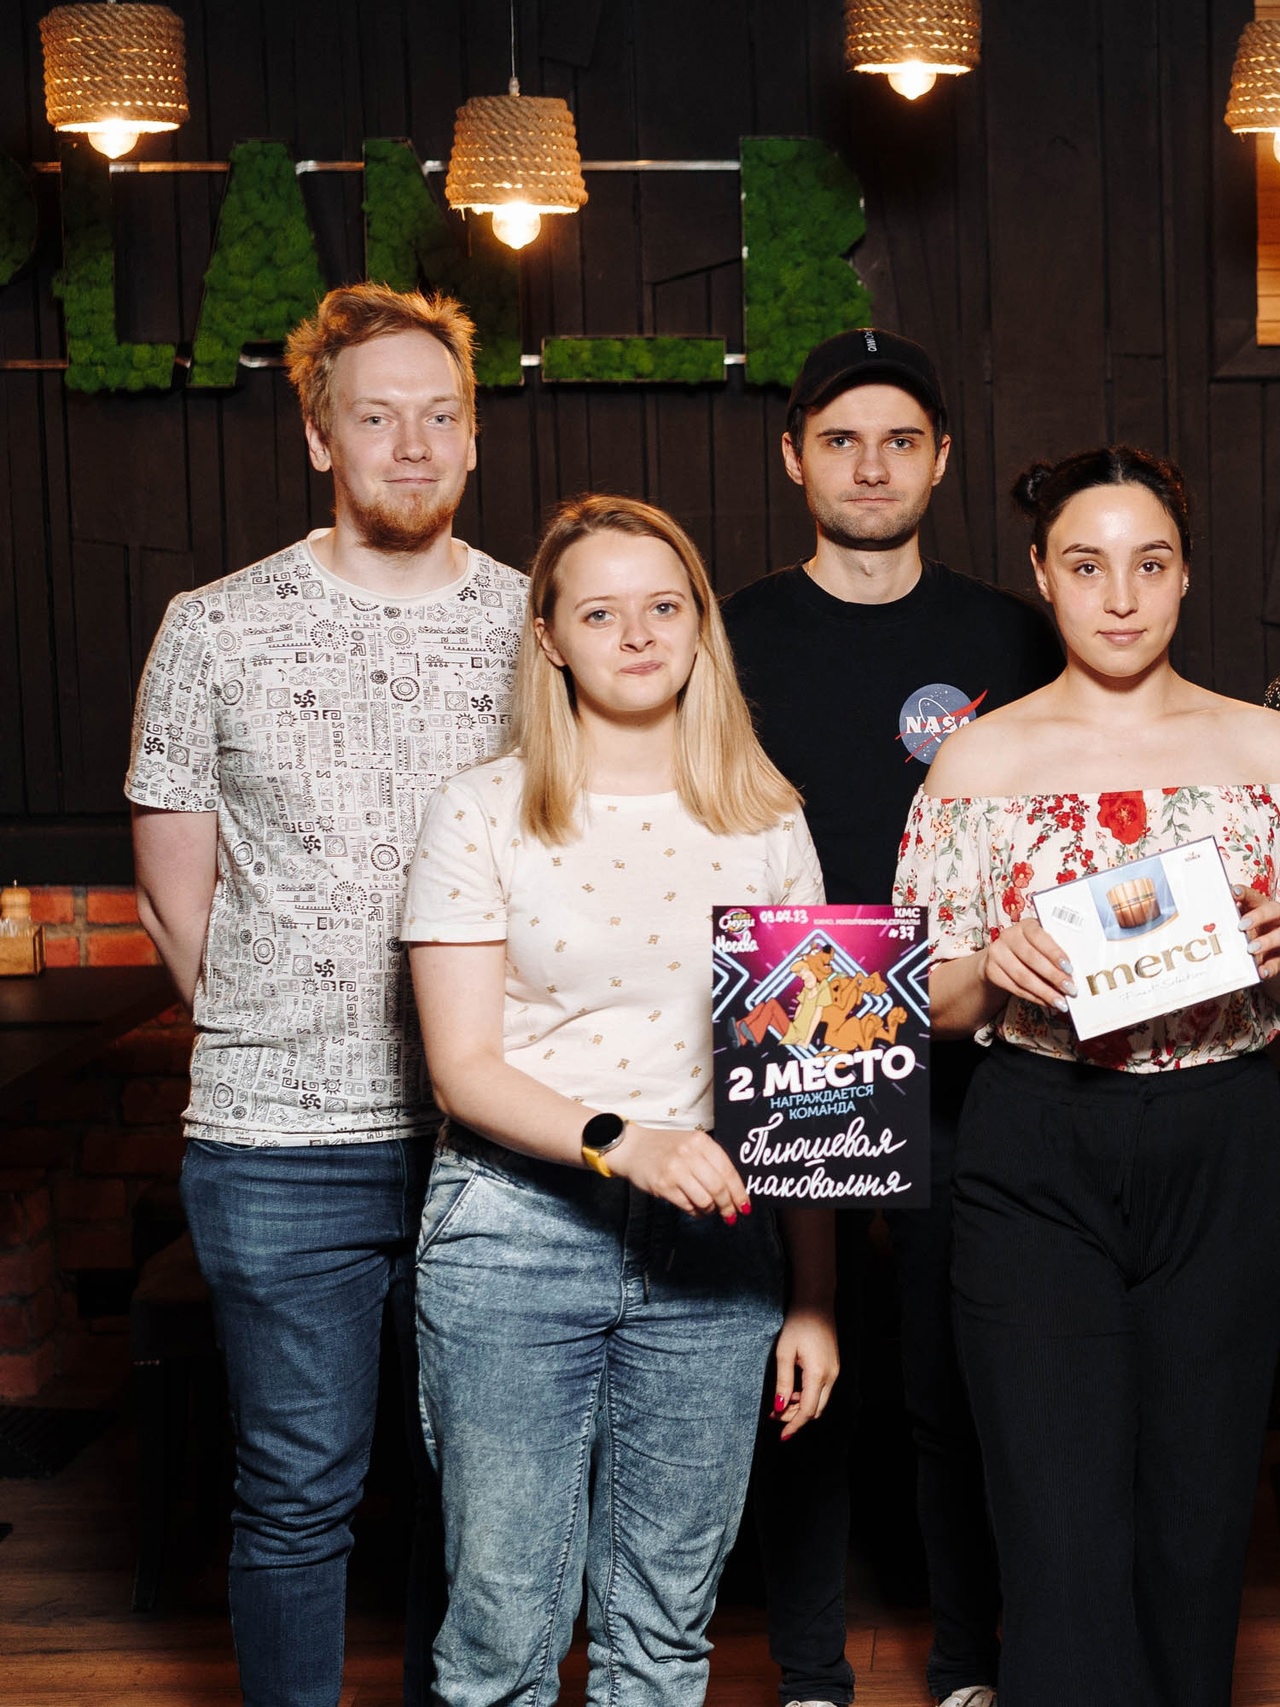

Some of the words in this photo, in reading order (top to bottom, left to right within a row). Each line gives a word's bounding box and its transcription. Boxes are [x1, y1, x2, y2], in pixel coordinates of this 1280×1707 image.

[894, 908, 921, 918] КМС
[1085, 931, 1223, 996] merci
[728, 1066, 755, 1102] 2
[763, 1045, 916, 1098] МЕСТО
[770, 1084, 875, 1110] НАГРАЖДАЕТСЯ
[788, 1101, 857, 1120] КОМАНДА
[739, 1112, 908, 1168] Плюшевая
[746, 1166, 912, 1200] наковальня
